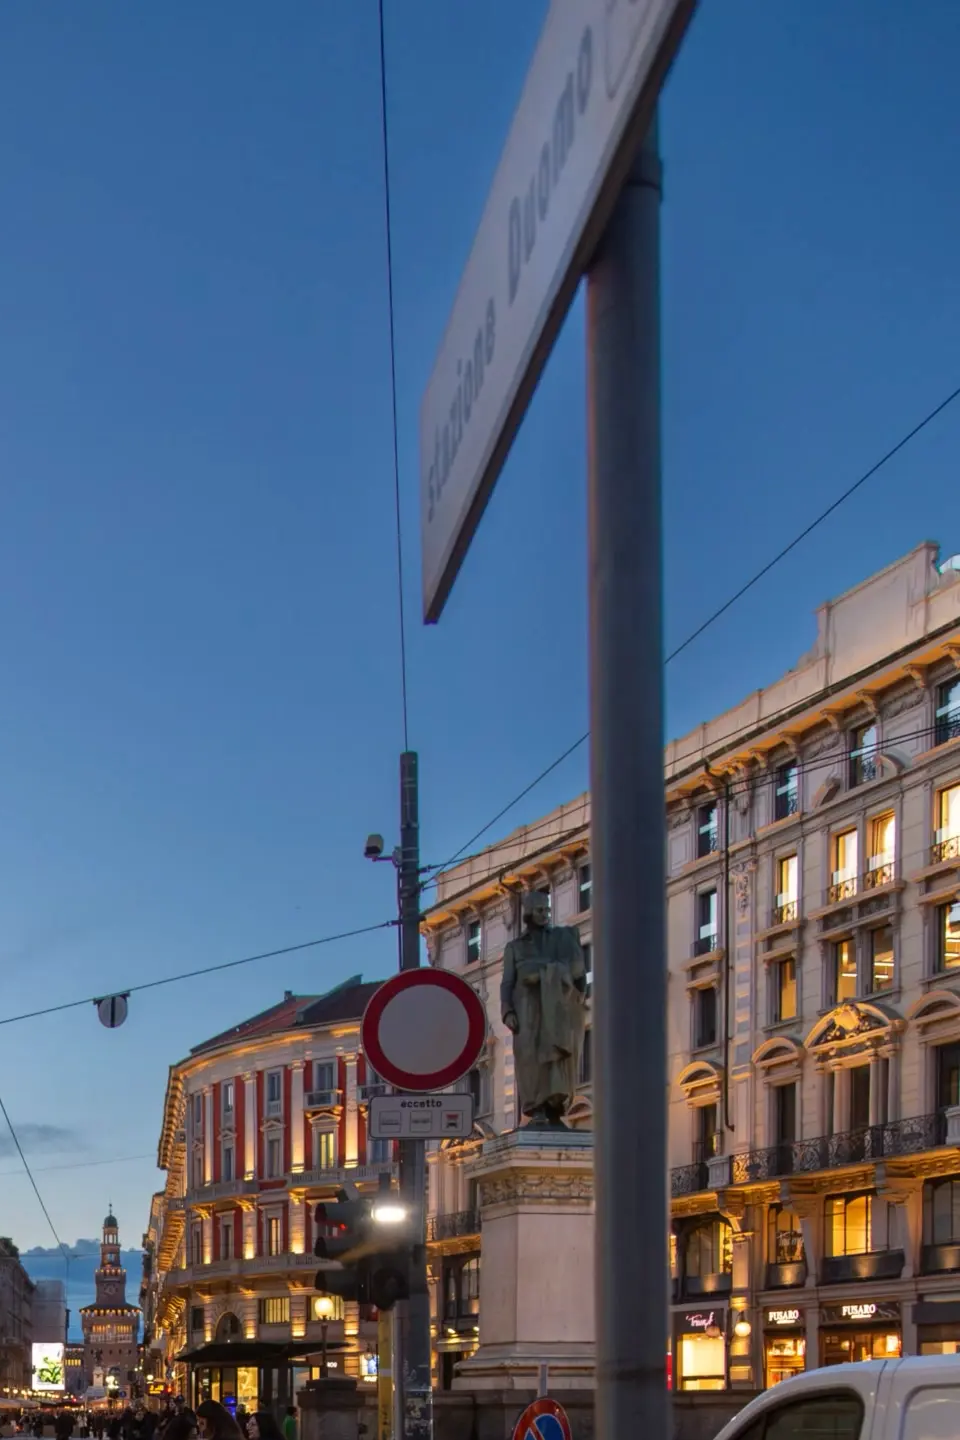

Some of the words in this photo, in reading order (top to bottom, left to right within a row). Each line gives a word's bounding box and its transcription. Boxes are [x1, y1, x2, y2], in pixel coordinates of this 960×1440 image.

[427, 295, 497, 523] stazione
[506, 25, 595, 307] Duomo
[400, 1099, 442, 1108] eccetto
[769, 1309, 799, 1321] FUSARO
[842, 1304, 877, 1316] FUSARO
